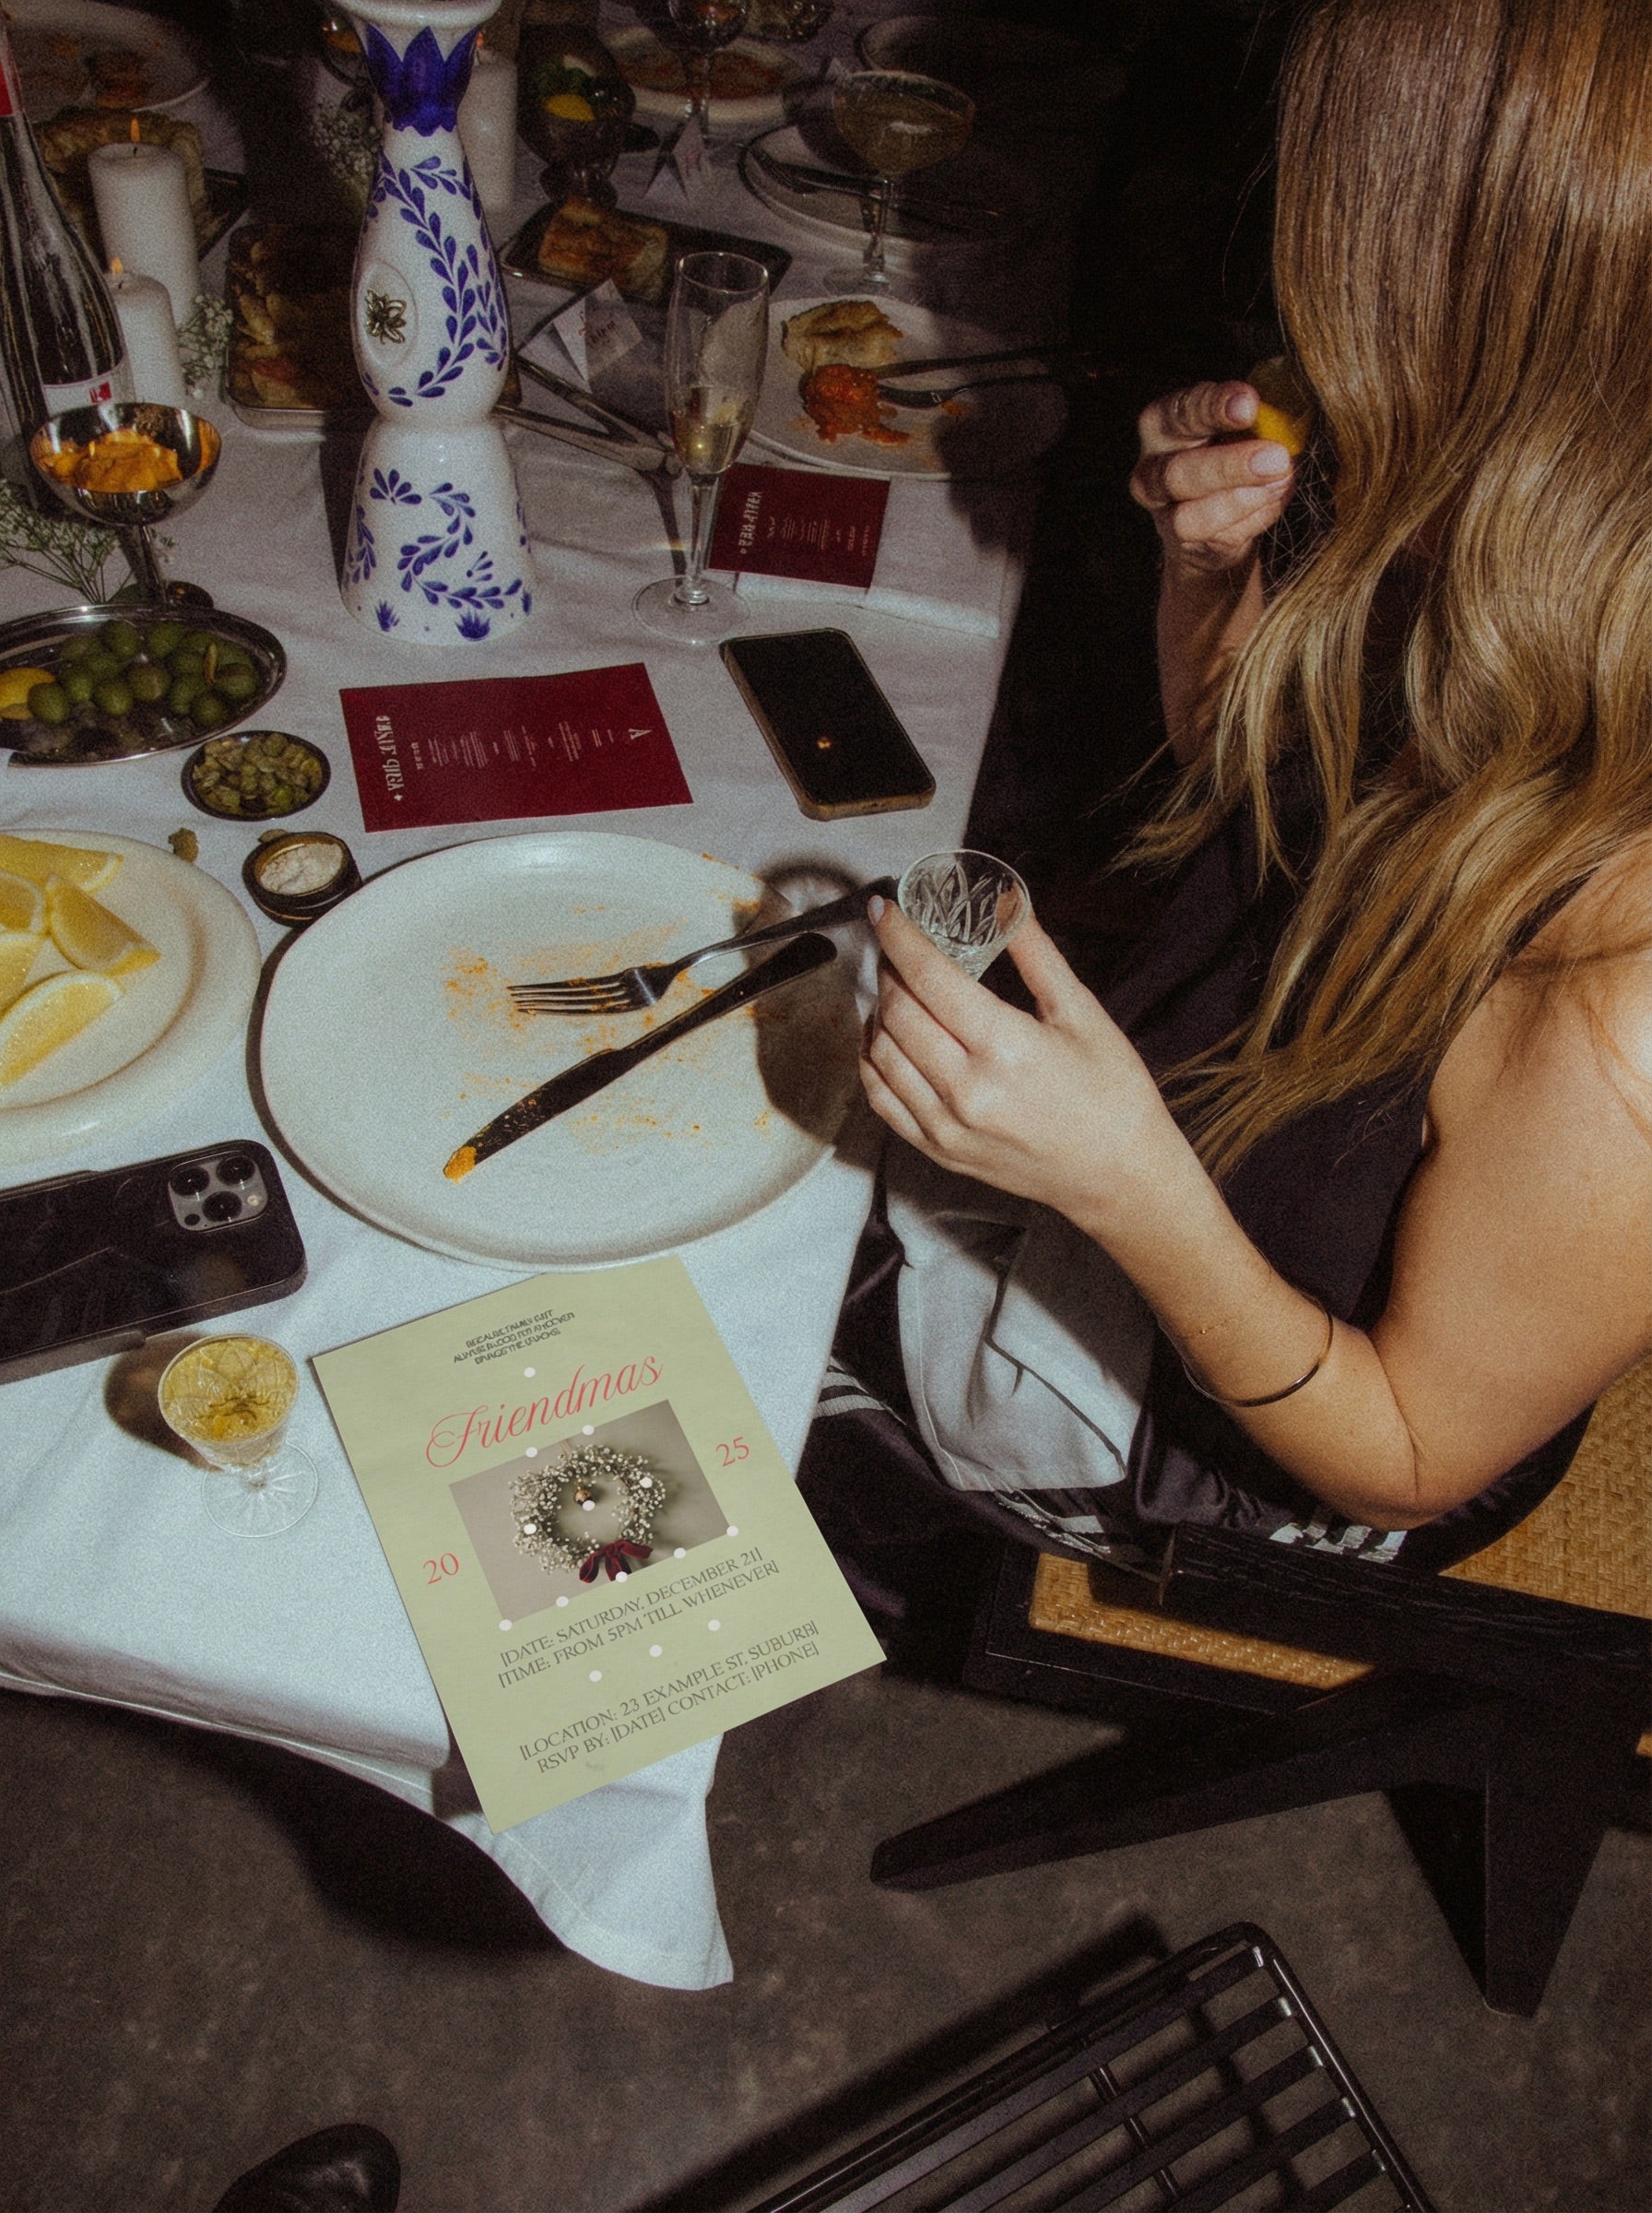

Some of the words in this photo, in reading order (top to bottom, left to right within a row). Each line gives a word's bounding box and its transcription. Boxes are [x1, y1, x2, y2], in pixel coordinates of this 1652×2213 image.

[425, 1355, 664, 1468] Friendmas
[715, 1437, 750, 1467] 25
[423, 1553, 460, 1585] 20
[646, 1559, 739, 1604] DECEMBER
[553, 1634, 604, 1664] FROM
[608, 1617, 643, 1641] 5PM
[643, 1604, 682, 1624] TILL
[620, 1698, 639, 1716] 23
[643, 1662, 725, 1705] EXAMPLE
[537, 1746, 579, 1773] RSVP
[584, 1734, 609, 1753] BY:
[668, 1672, 750, 1714] CONTACT:
